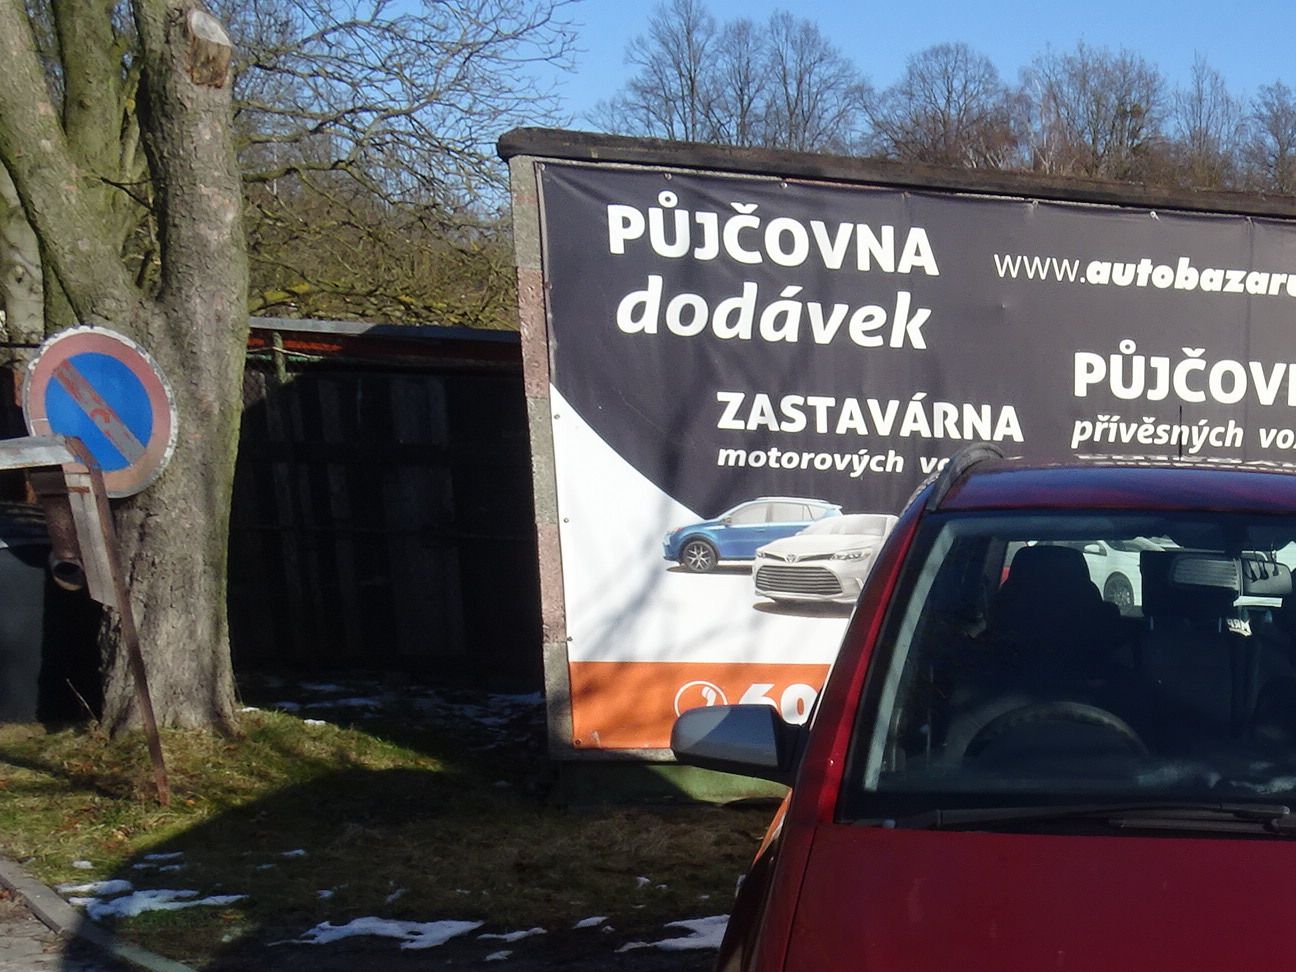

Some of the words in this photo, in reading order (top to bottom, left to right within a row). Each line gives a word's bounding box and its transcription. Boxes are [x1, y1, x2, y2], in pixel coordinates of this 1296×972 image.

[607, 190, 940, 276] PŮJČOVNA
[615, 274, 932, 350] dodávek
[716, 391, 1024, 442] ZASTAVÁRNA
[1071, 413, 1244, 455] přívěsných
[717, 445, 904, 479] motorových
